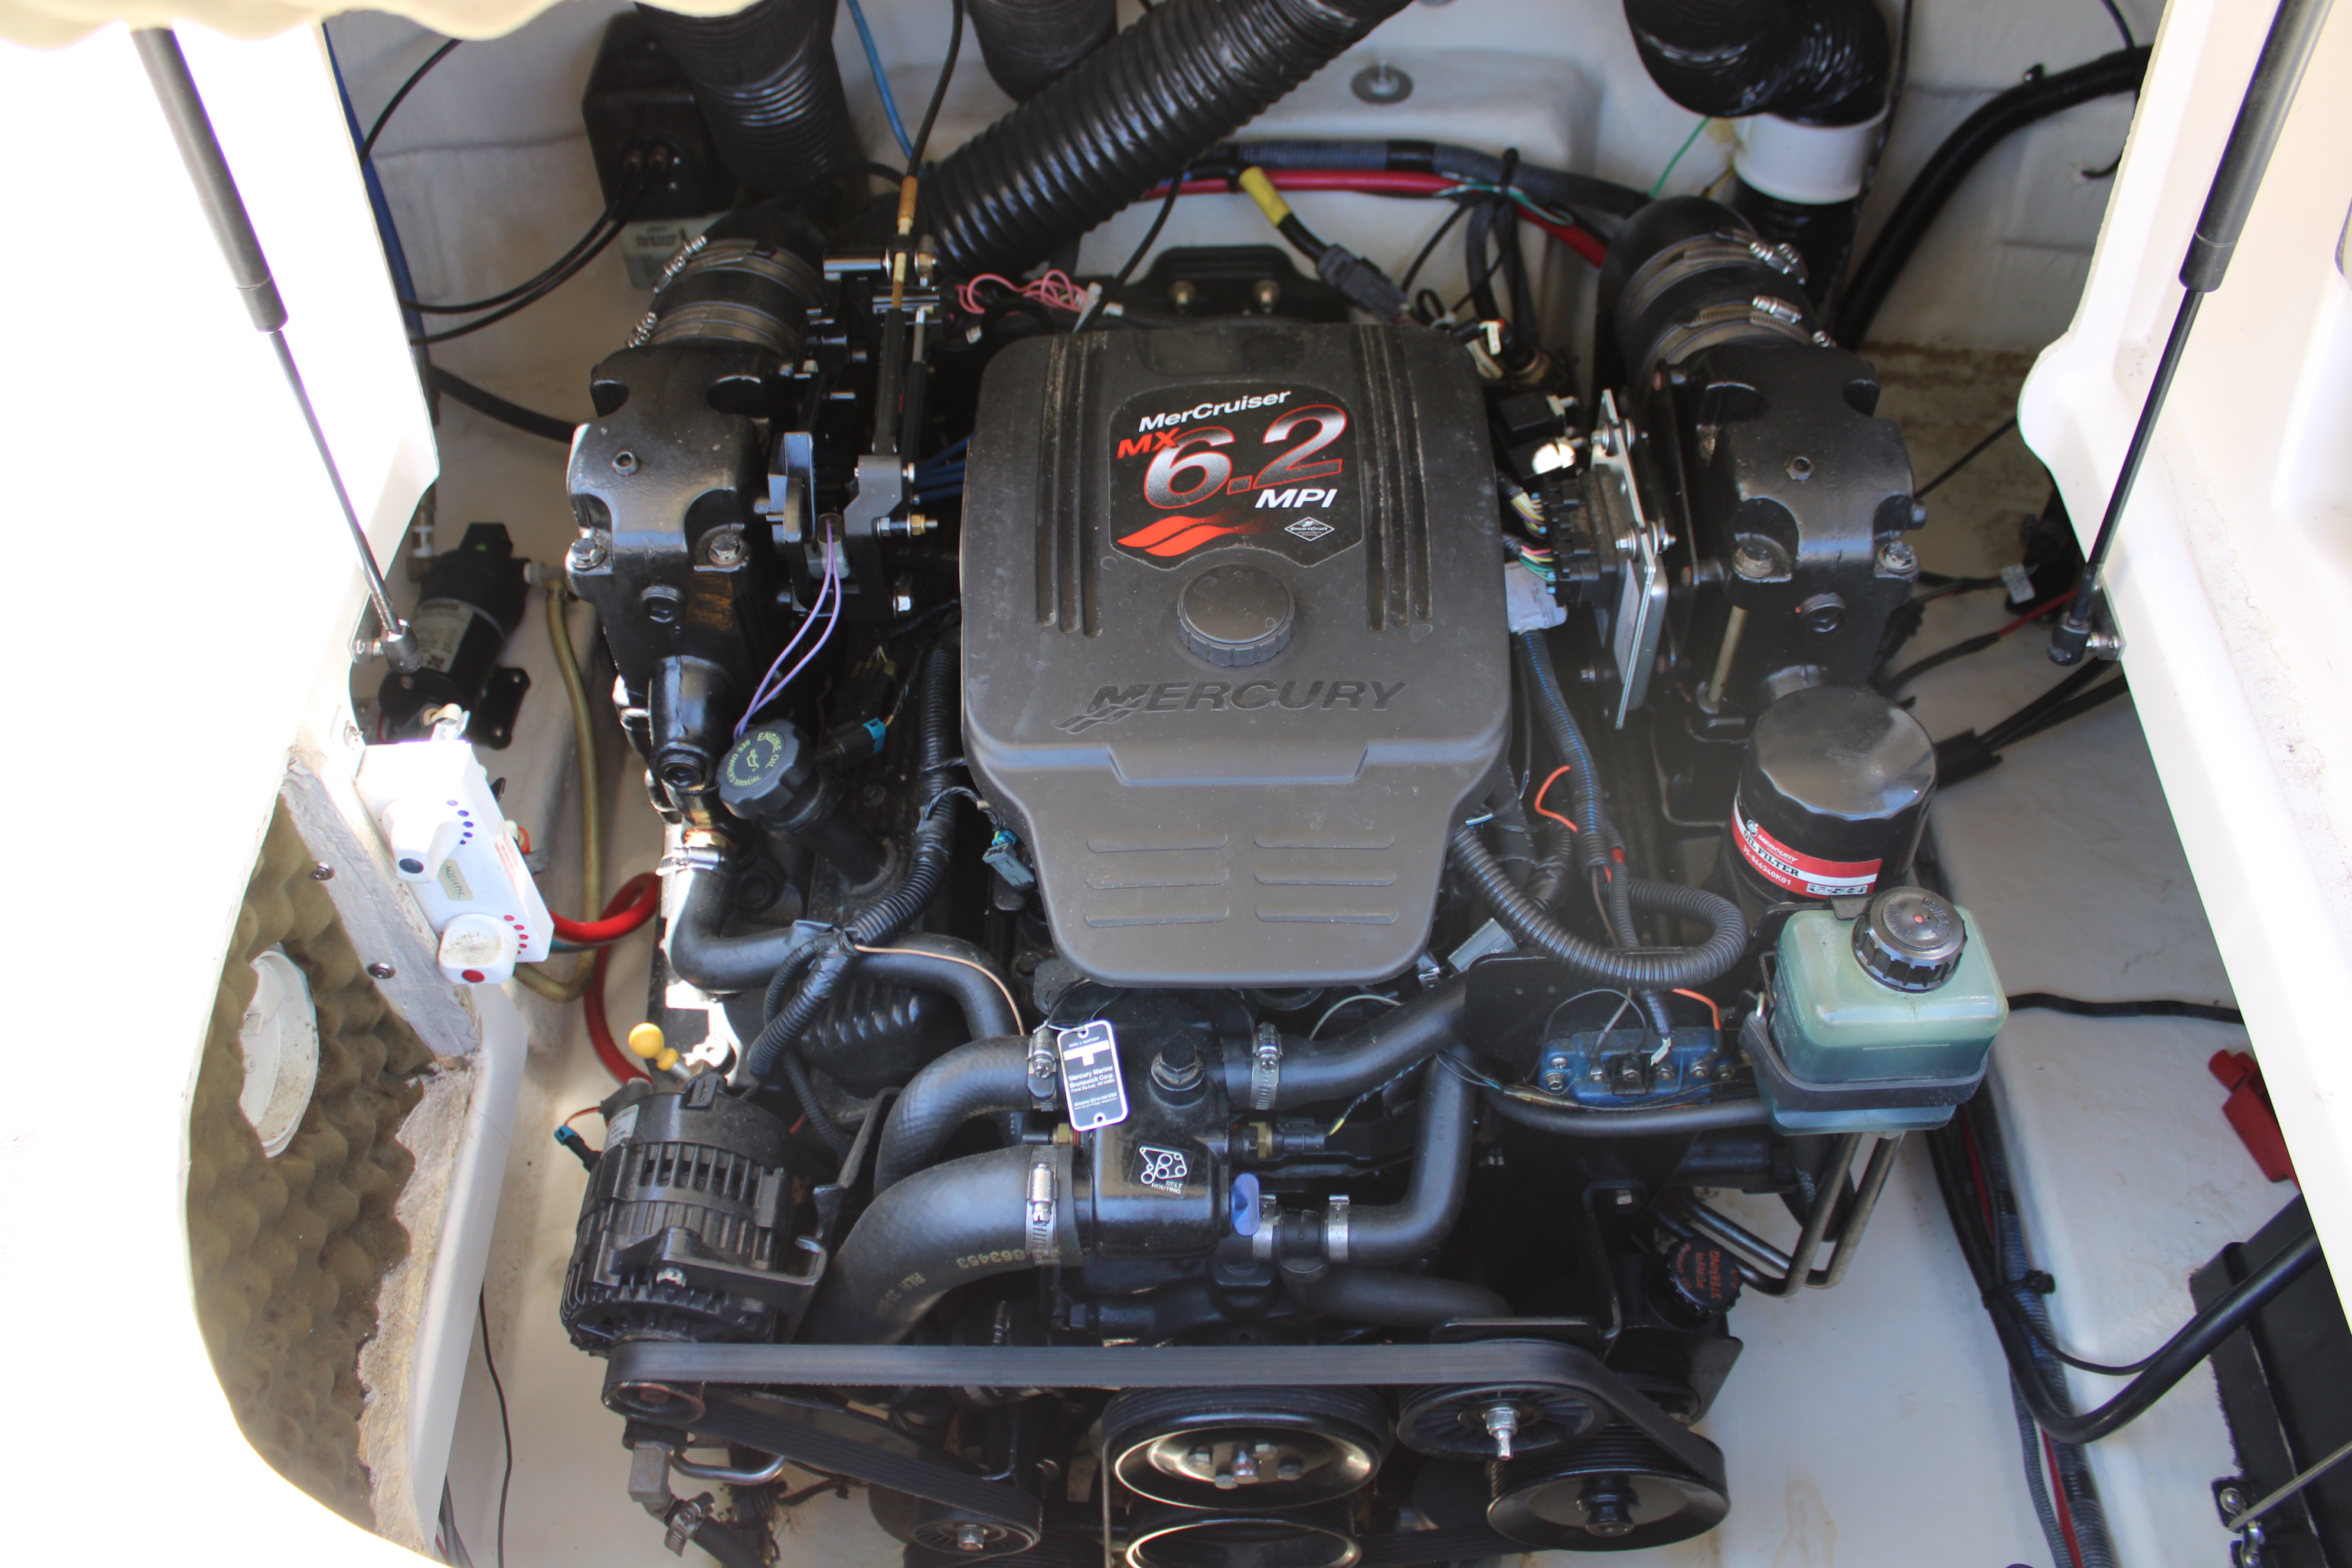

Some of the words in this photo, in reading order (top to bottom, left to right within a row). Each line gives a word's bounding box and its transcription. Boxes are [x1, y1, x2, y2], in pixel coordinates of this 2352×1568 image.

[1138, 390, 1291, 432] MerCruiser
[1117, 427, 1180, 459] MX
[1144, 404, 1347, 509] 6.2
[1255, 488, 1338, 508] MPI
[1084, 680, 1408, 713] MERCURY
[736, 739, 751, 753] SEE
[757, 731, 782, 753] ENGINE
[765, 754, 779, 769] OIL
[733, 775, 762, 787] MANUAL
[1743, 830, 1756, 850] OIL
[1758, 847, 1799, 877] FILTER
[1758, 835, 1799, 861] MERCURY
[1743, 845, 1792, 886] 35-866340K01
[1068, 1072, 1092, 1082] Mercury
[1093, 1066, 1113, 1075] Marine
[1070, 1077, 1098, 1088] Brunswick
[1151, 1182, 1181, 1194] ROUTING
[1165, 1180, 1182, 1188] BELT
[1696, 1252, 1707, 1289] POWER
[1710, 1250, 1722, 1298] STEERING
